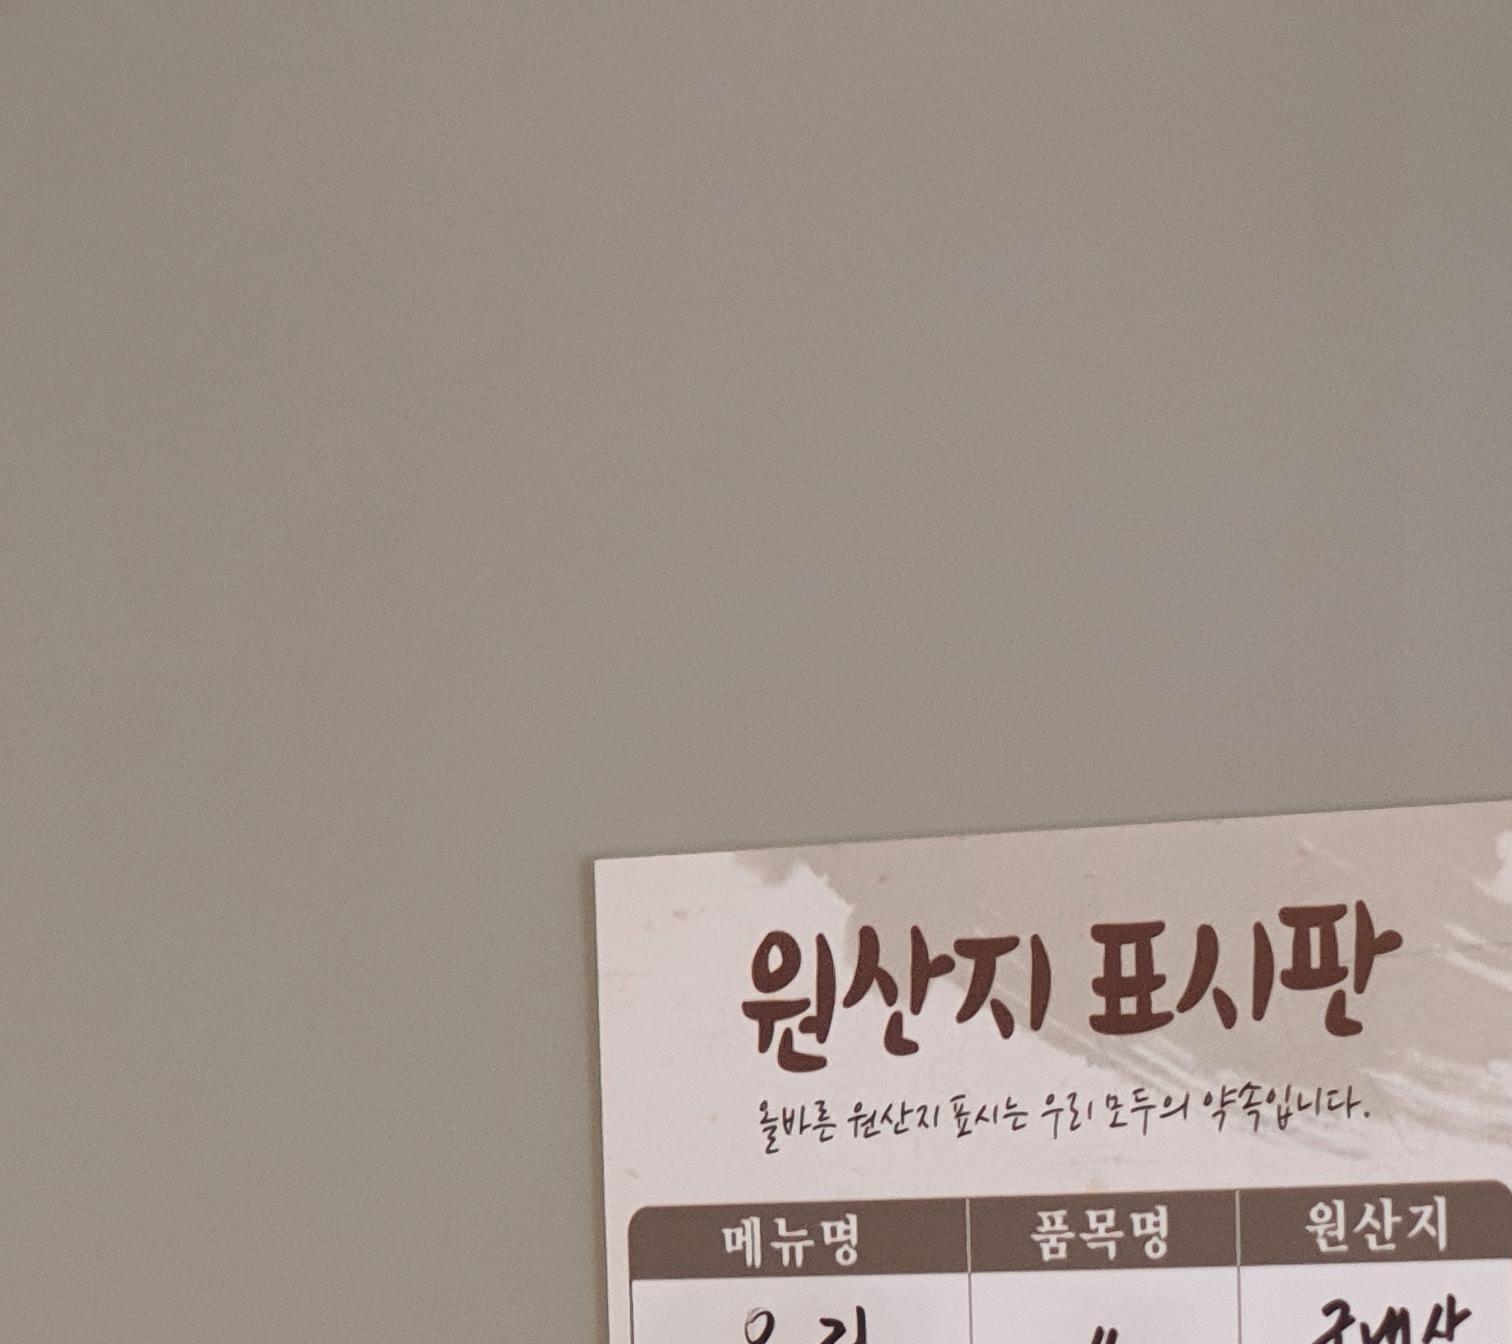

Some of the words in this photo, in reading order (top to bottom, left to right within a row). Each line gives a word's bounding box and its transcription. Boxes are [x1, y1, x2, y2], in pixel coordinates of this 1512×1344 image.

[741, 924, 1052, 1073] 원산지
[1088, 899, 1404, 1038] 표시판
[759, 1099, 837, 1155] 올바른
[847, 1101, 940, 1139] 원산지
[949, 1093, 1029, 1139] 표시는
[1040, 1091, 1093, 1140] 우리
[1105, 1087, 1191, 1136] 모두의
[1202, 1081, 1371, 1133] 약속입니다.
[722, 1213, 859, 1267] 메뉴명
[1030, 1204, 1169, 1260] 품목명
[1305, 1195, 1450, 1254] 원산지
